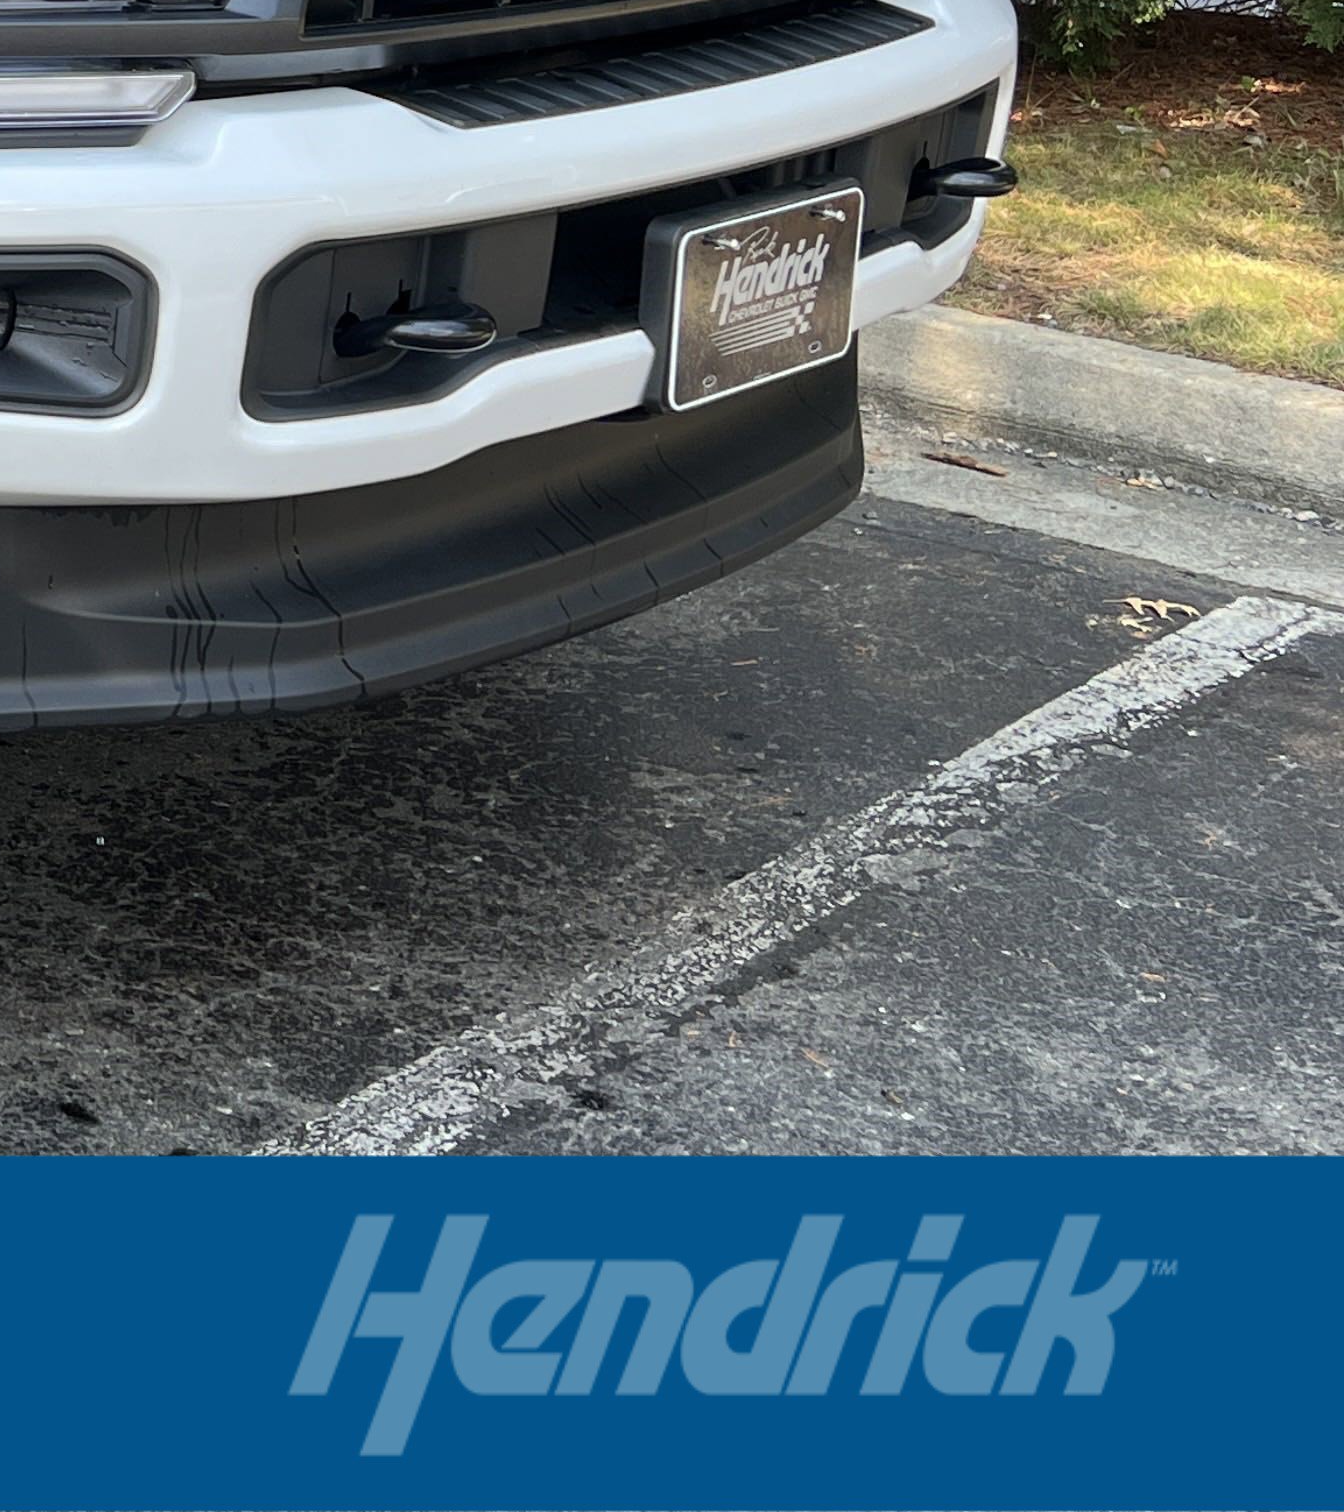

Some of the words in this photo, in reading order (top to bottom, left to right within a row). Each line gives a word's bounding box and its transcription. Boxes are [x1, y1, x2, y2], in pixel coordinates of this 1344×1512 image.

[709, 232, 831, 327] Hendrick
[728, 299, 776, 324] CHEVROLET
[775, 293, 799, 311] BUICK
